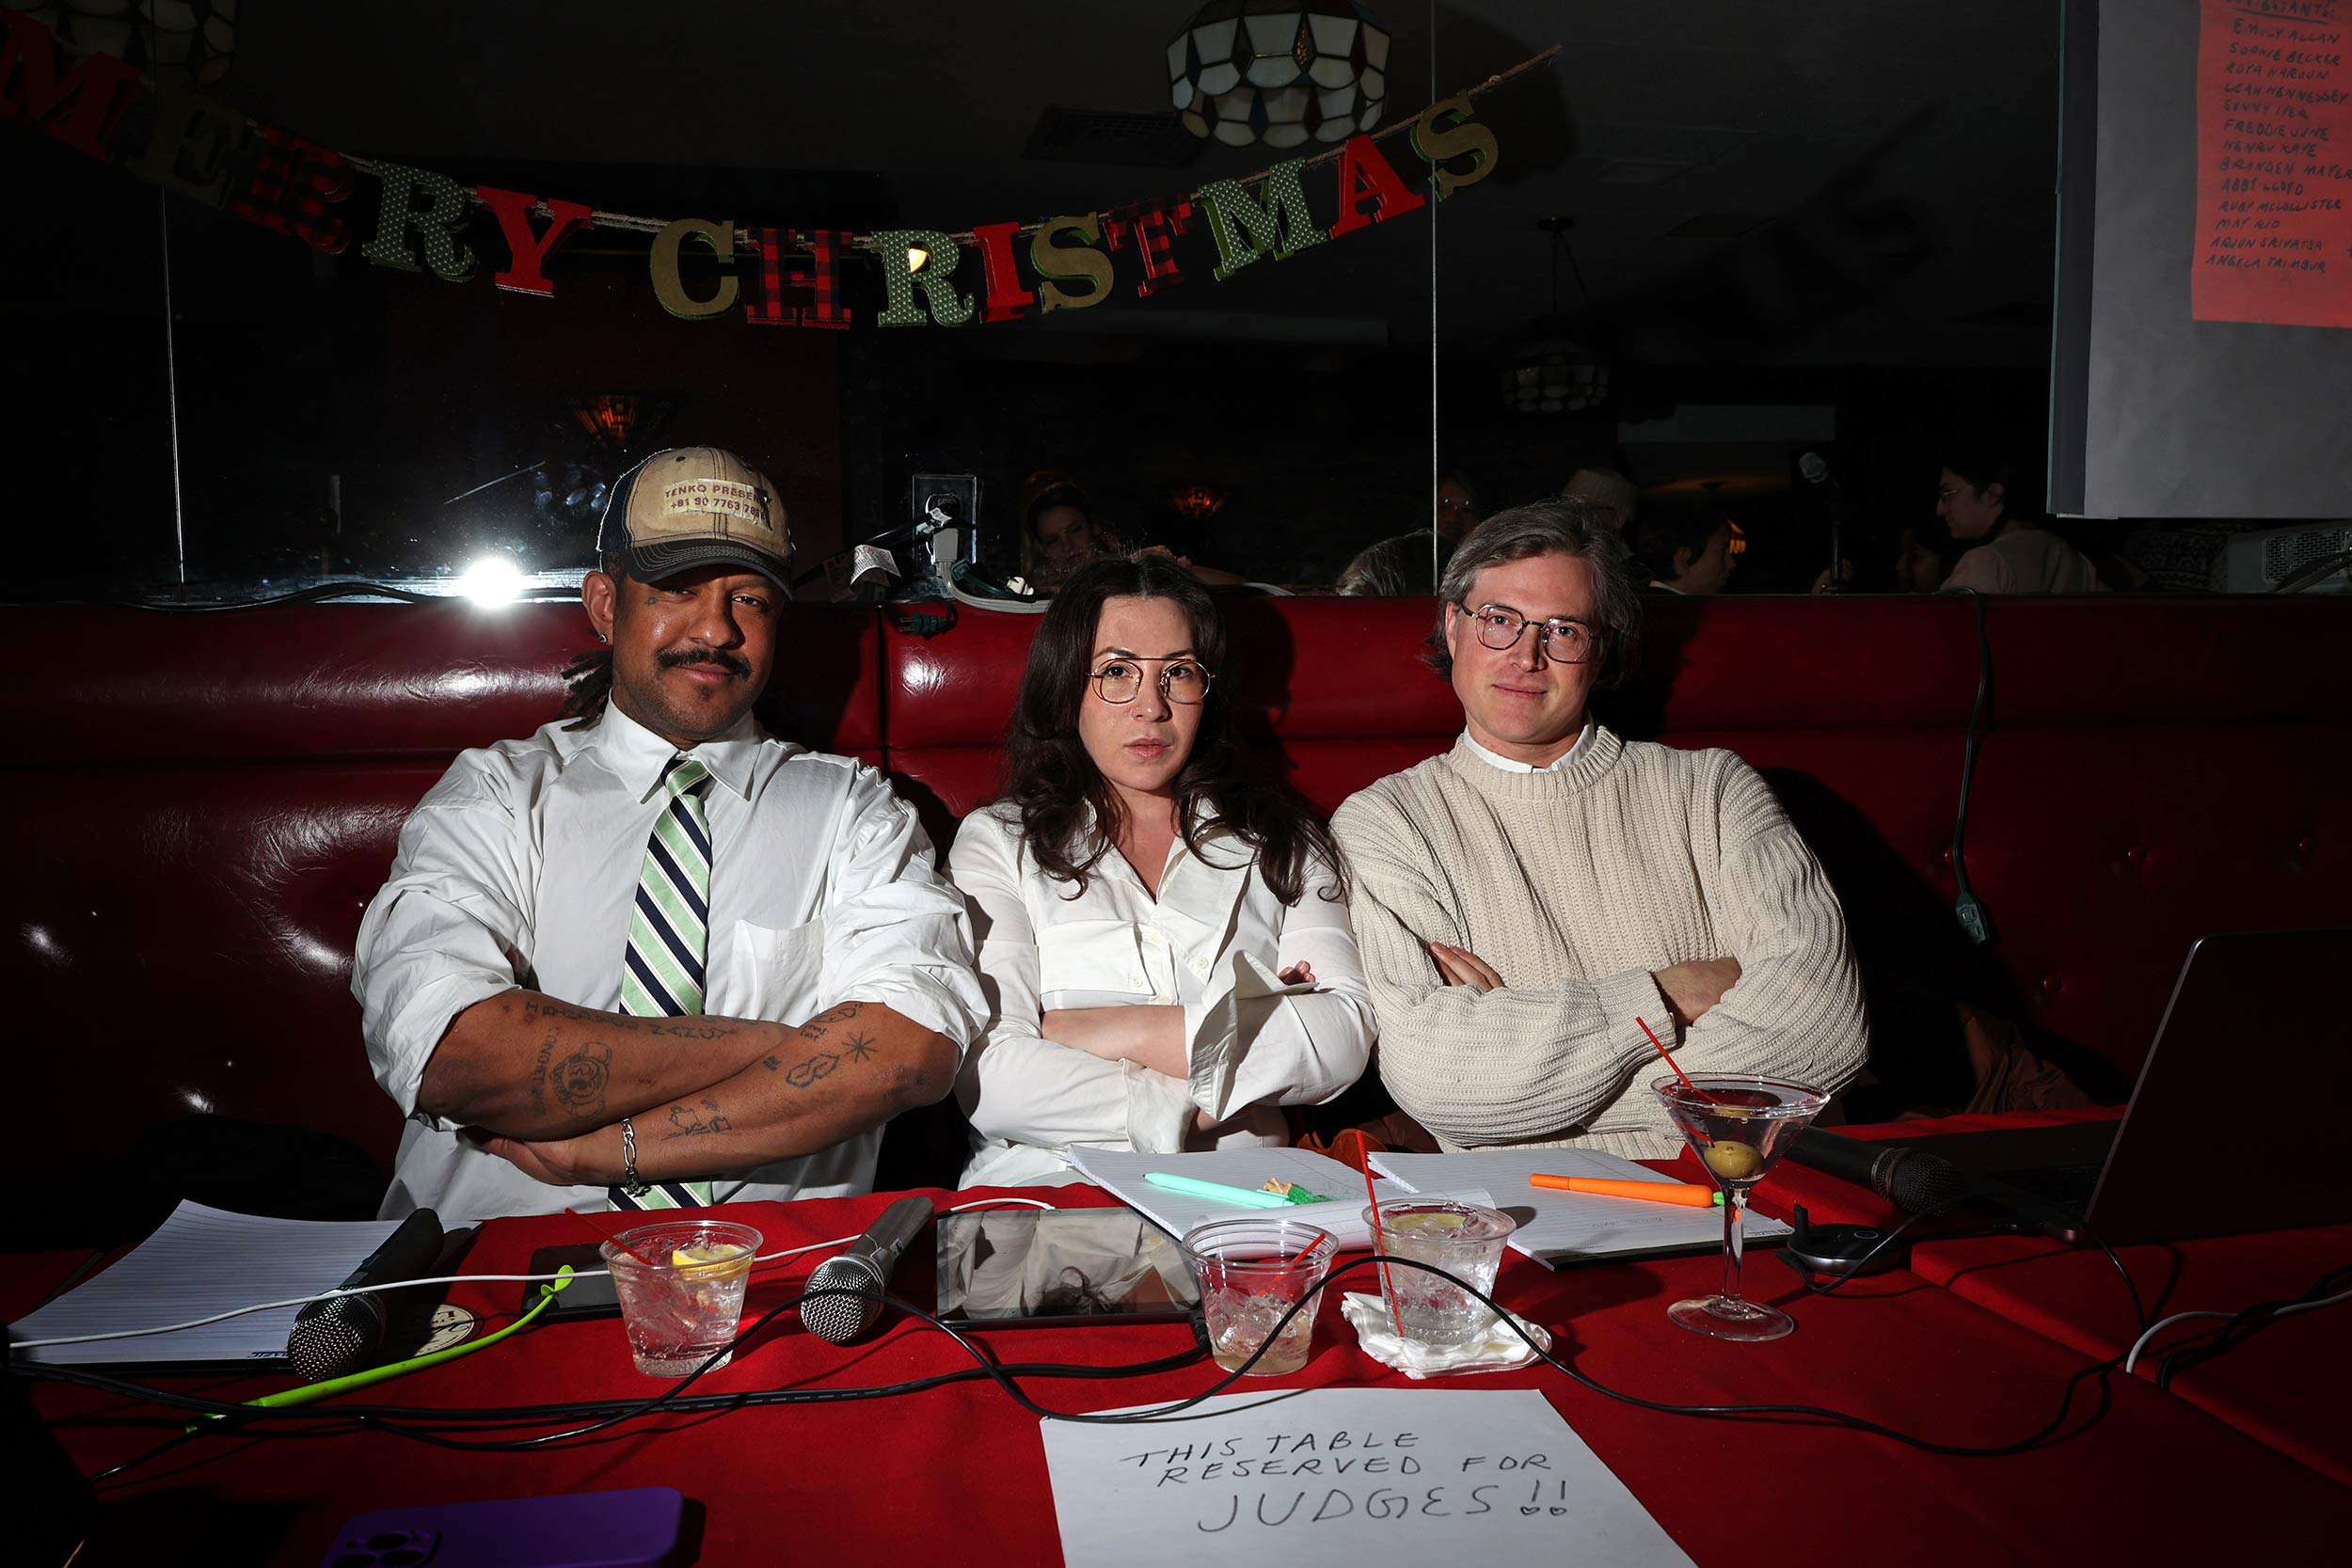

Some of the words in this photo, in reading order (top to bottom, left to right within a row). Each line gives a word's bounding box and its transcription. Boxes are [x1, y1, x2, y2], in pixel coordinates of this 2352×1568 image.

[2233, 17, 2287, 40] EMILY
[2288, 29, 2342, 44] ALLAN
[2286, 50, 2342, 66] BECKER
[2223, 83, 2262, 97] LEAH
[2265, 86, 2349, 104] HENNESSEY
[2223, 98, 2271, 116] SUNNY
[2223, 118, 2287, 136] FREDDIE
[2290, 127, 2330, 142] JUNE
[2220, 177, 2258, 194] ABBY
[2262, 181, 2304, 196] LLOYD
[648, 91, 1502, 330] CHRISTMAS
[2218, 199, 2255, 213] RUBY
[2253, 219, 2280, 230] RIO
[2209, 236, 2257, 249] ARJUN
[2204, 254, 2261, 269] ANGELA
[665, 484, 707, 498] TENKO
[671, 499, 690, 509] +81
[694, 498, 708, 506] 90
[714, 499, 740, 511] 7763
[1120, 1438, 1242, 1467] THIS
[1266, 1431, 1419, 1453] TABLE
[1157, 1455, 1421, 1487] RESERVED
[1462, 1453, 1550, 1472] FOR
